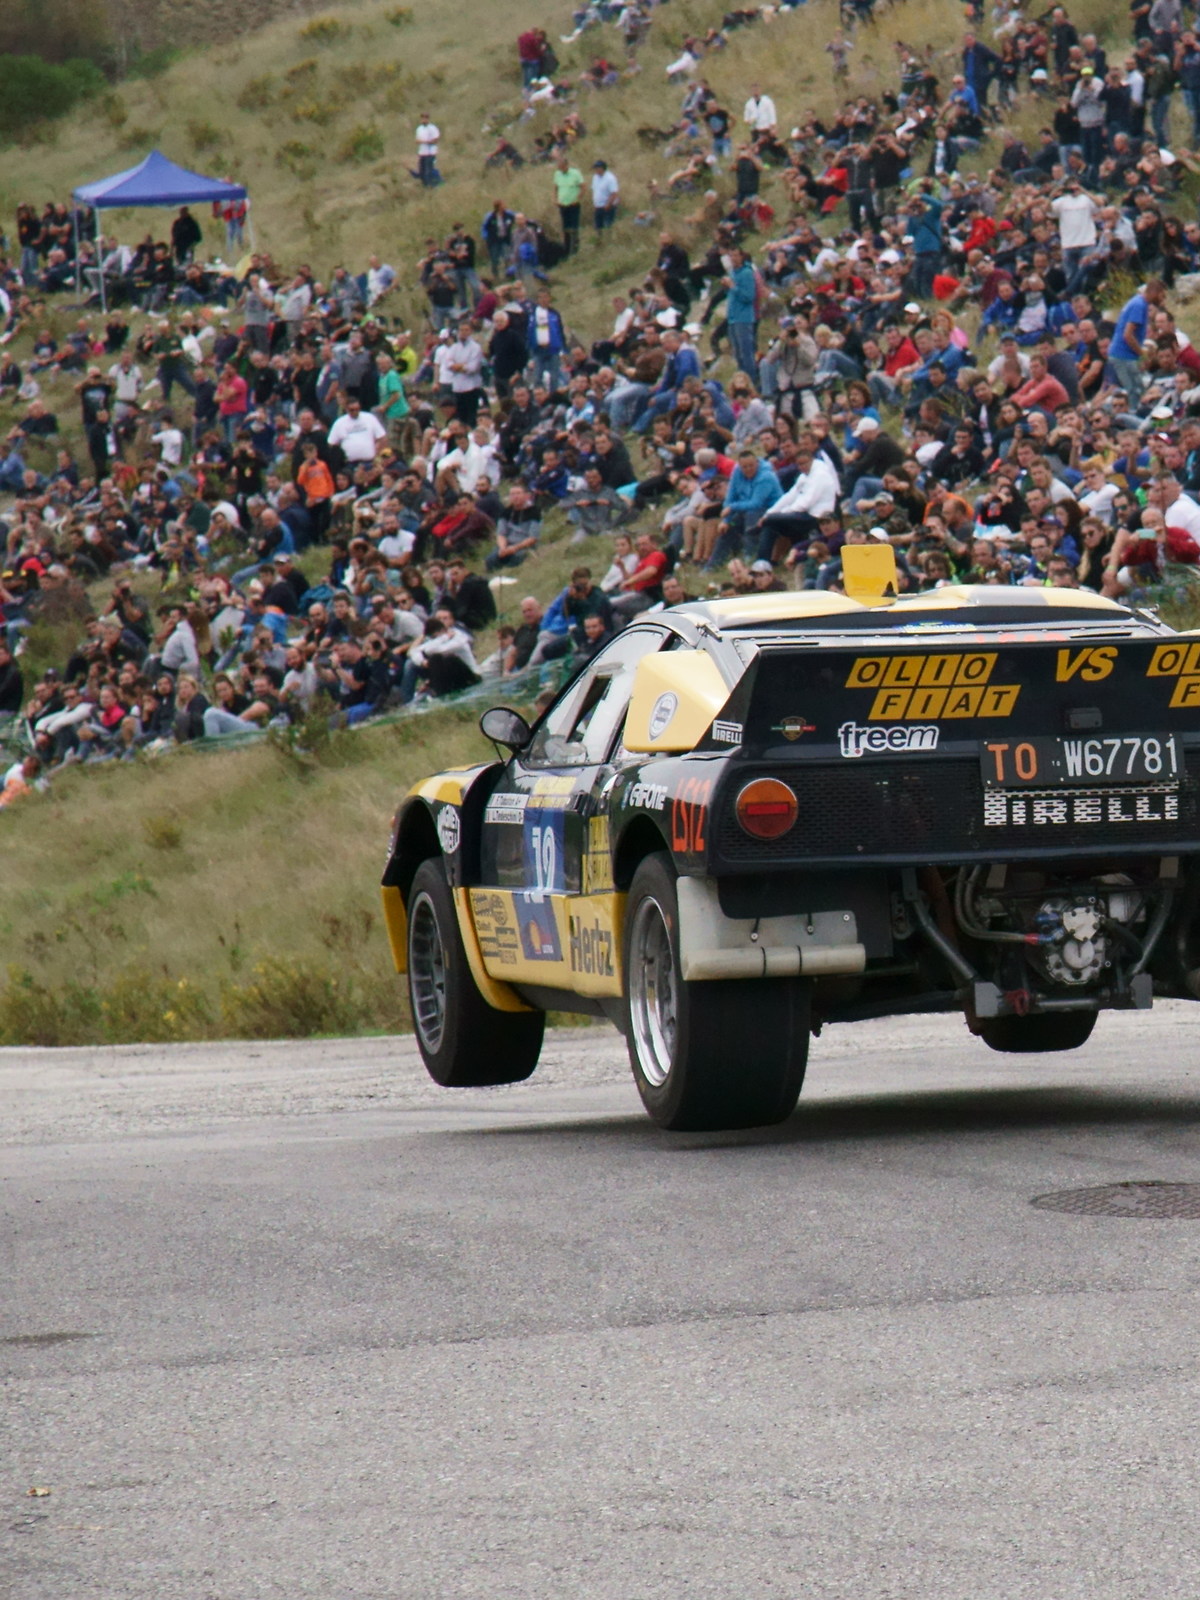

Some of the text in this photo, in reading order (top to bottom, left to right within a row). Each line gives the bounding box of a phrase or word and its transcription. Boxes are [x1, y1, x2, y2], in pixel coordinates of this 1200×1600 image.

[855, 656, 988, 683] OLIO
[1056, 646, 1119, 682] VS
[879, 690, 1012, 715] FIAT
[712, 719, 743, 744] PIRELLI
[838, 721, 939, 752] freem
[987, 742, 1038, 781] TO
[1063, 737, 1178, 777] W67781
[569, 915, 615, 977] Hertz
